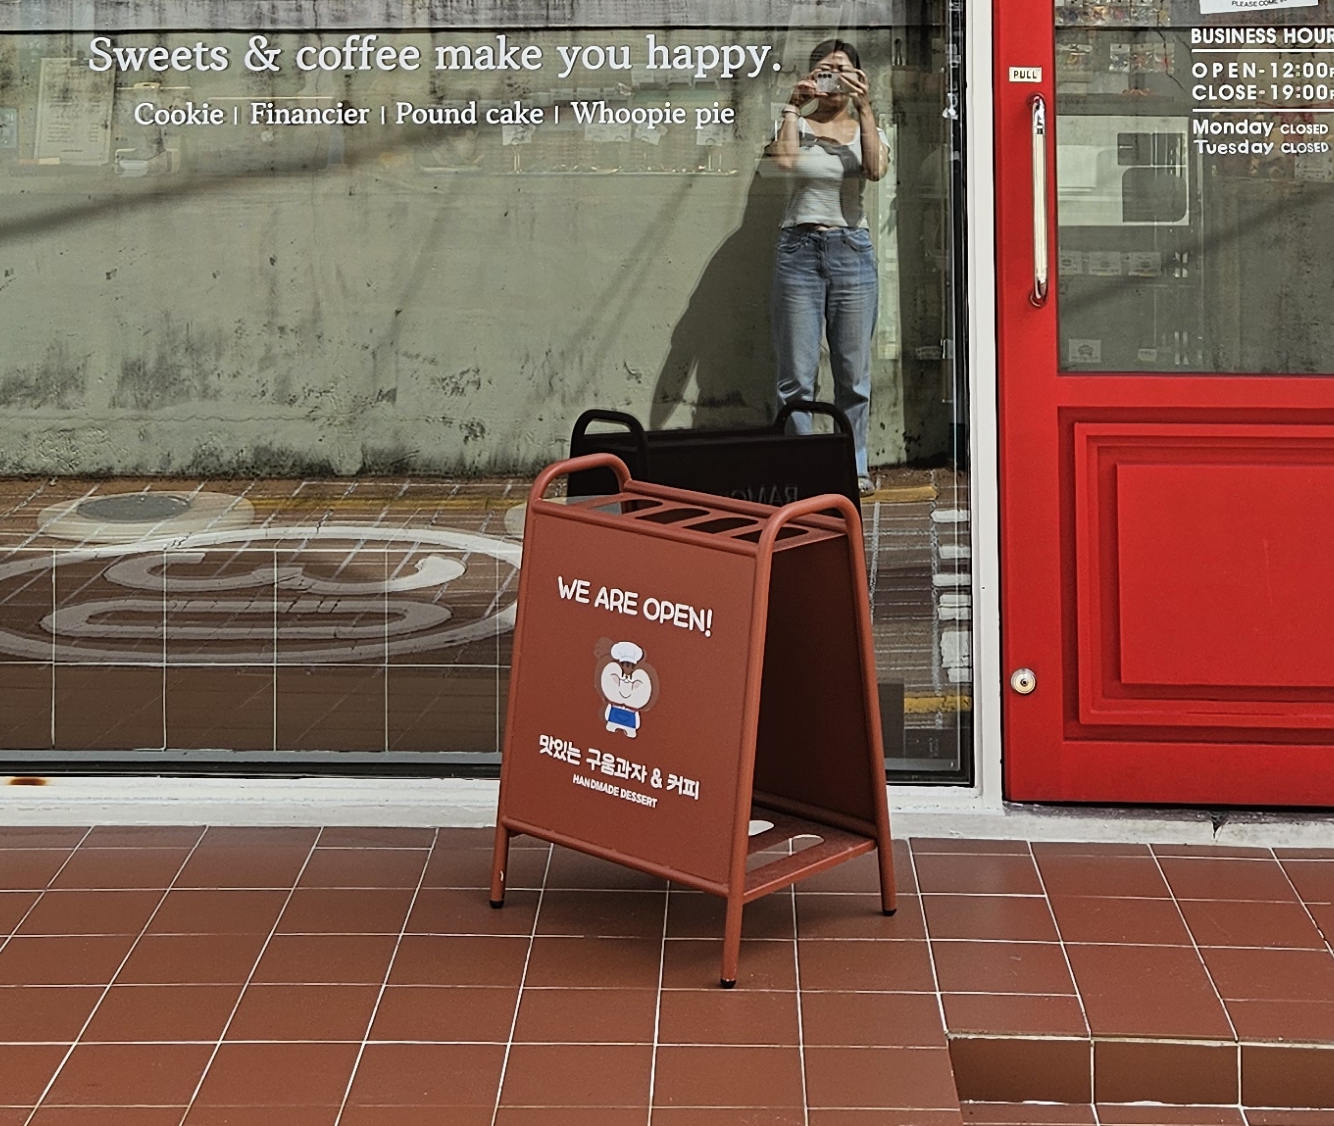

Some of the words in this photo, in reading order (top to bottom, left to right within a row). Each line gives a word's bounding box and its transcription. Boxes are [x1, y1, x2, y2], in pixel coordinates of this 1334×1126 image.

[1191, 27, 1277, 44] BUSINESS
[88, 36, 229, 72] Sweets
[244, 34, 282, 72] &
[296, 34, 420, 72] coffee
[435, 34, 543, 71] make
[557, 43, 633, 78] you
[646, 33, 781, 78] happy.
[1013, 70, 1037, 79] PULL
[134, 102, 224, 125] Cookie
[251, 102, 370, 125] Financier
[395, 101, 477, 125] Pound
[486, 101, 544, 124] cake
[571, 101, 686, 130] Whoopie
[695, 101, 735, 130] pie
[1193, 119, 1274, 137] Monday
[1280, 124, 1329, 135] CLOSED
[1193, 139, 1274, 155] Tuesday
[1281, 142, 1329, 154] CLOSED
[557, 575, 591, 604] WE
[594, 586, 639, 615] ARE
[642, 597, 713, 637] OPEN!
[539, 734, 581, 766] 맛있는
[586, 748, 647, 783] 구움과자
[650, 768, 663, 789] &
[666, 774, 700, 800] 커피
[572, 774, 619, 797] HANDMADE
[620, 787, 658, 808] DESSERT
